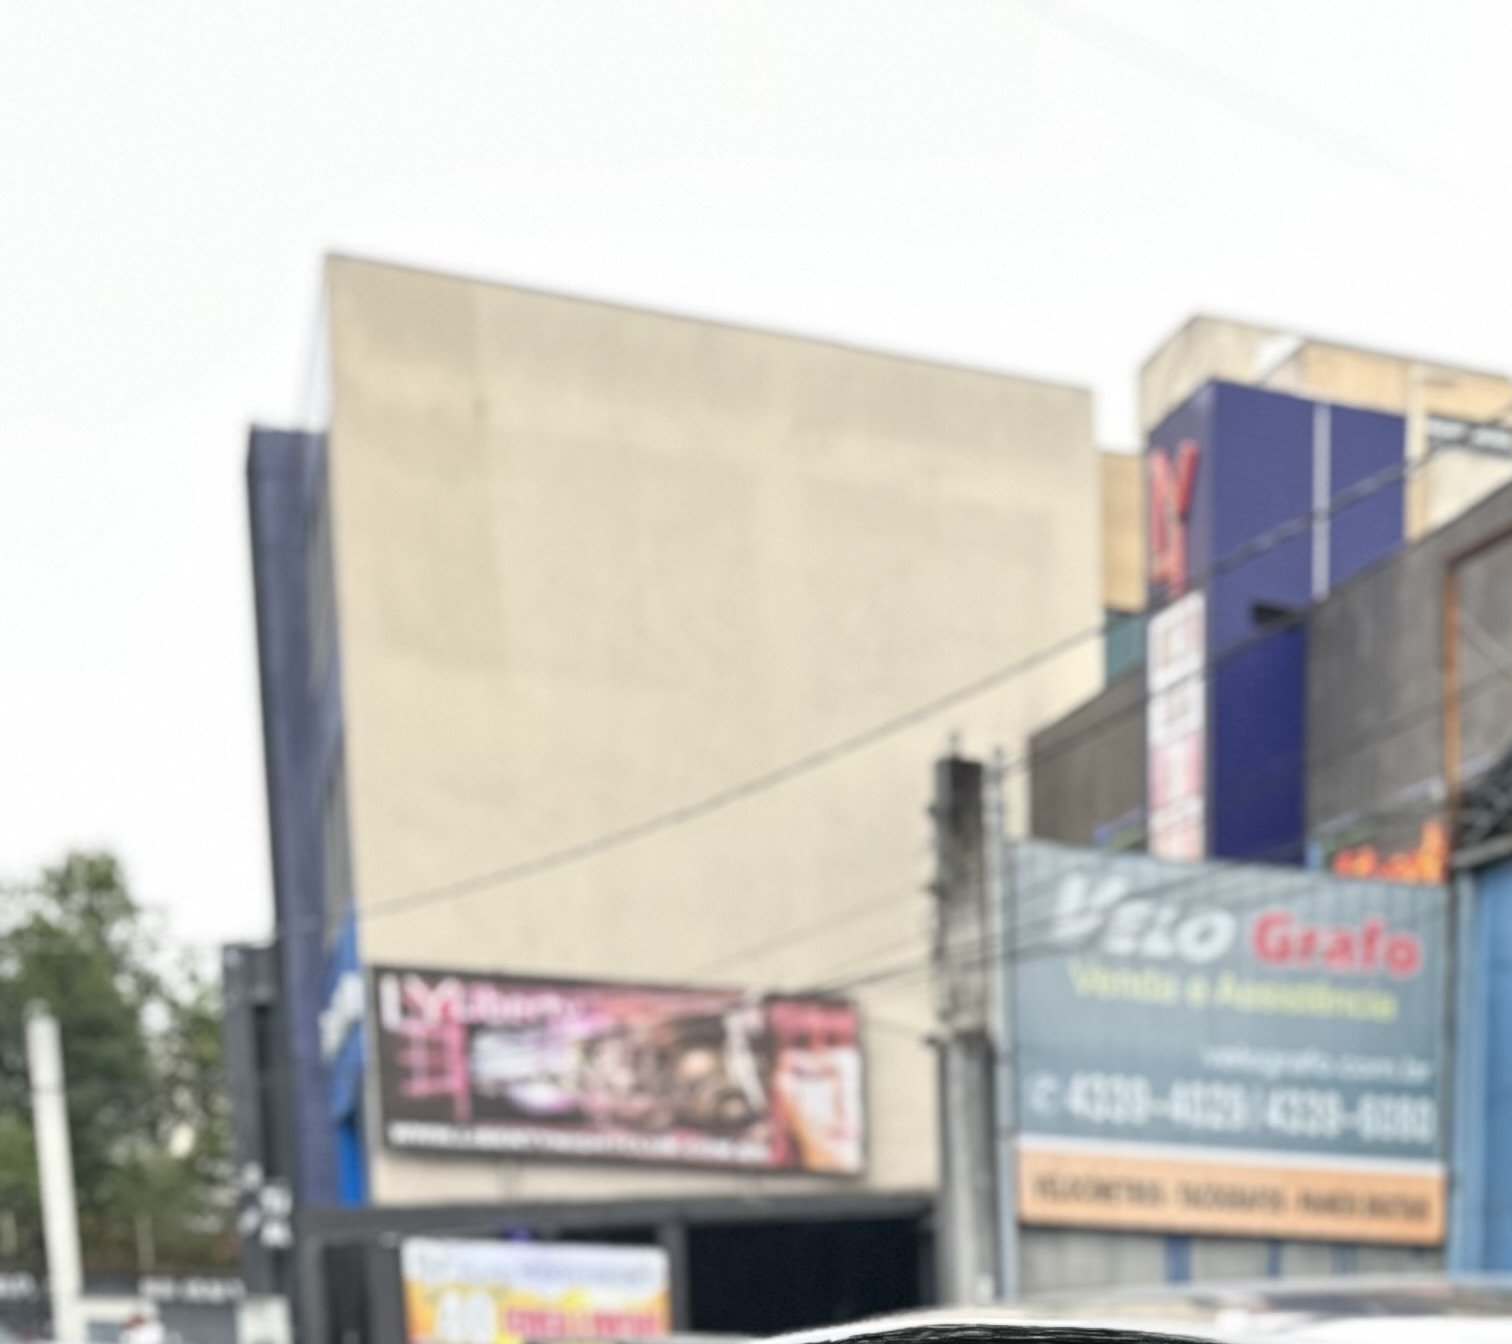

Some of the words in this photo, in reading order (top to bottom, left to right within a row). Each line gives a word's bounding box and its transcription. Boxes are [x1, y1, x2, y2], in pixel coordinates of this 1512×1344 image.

[1251, 910, 1423, 978] Grafo
[1068, 962, 1178, 1003] Venda
[1187, 978, 1208, 1010] e
